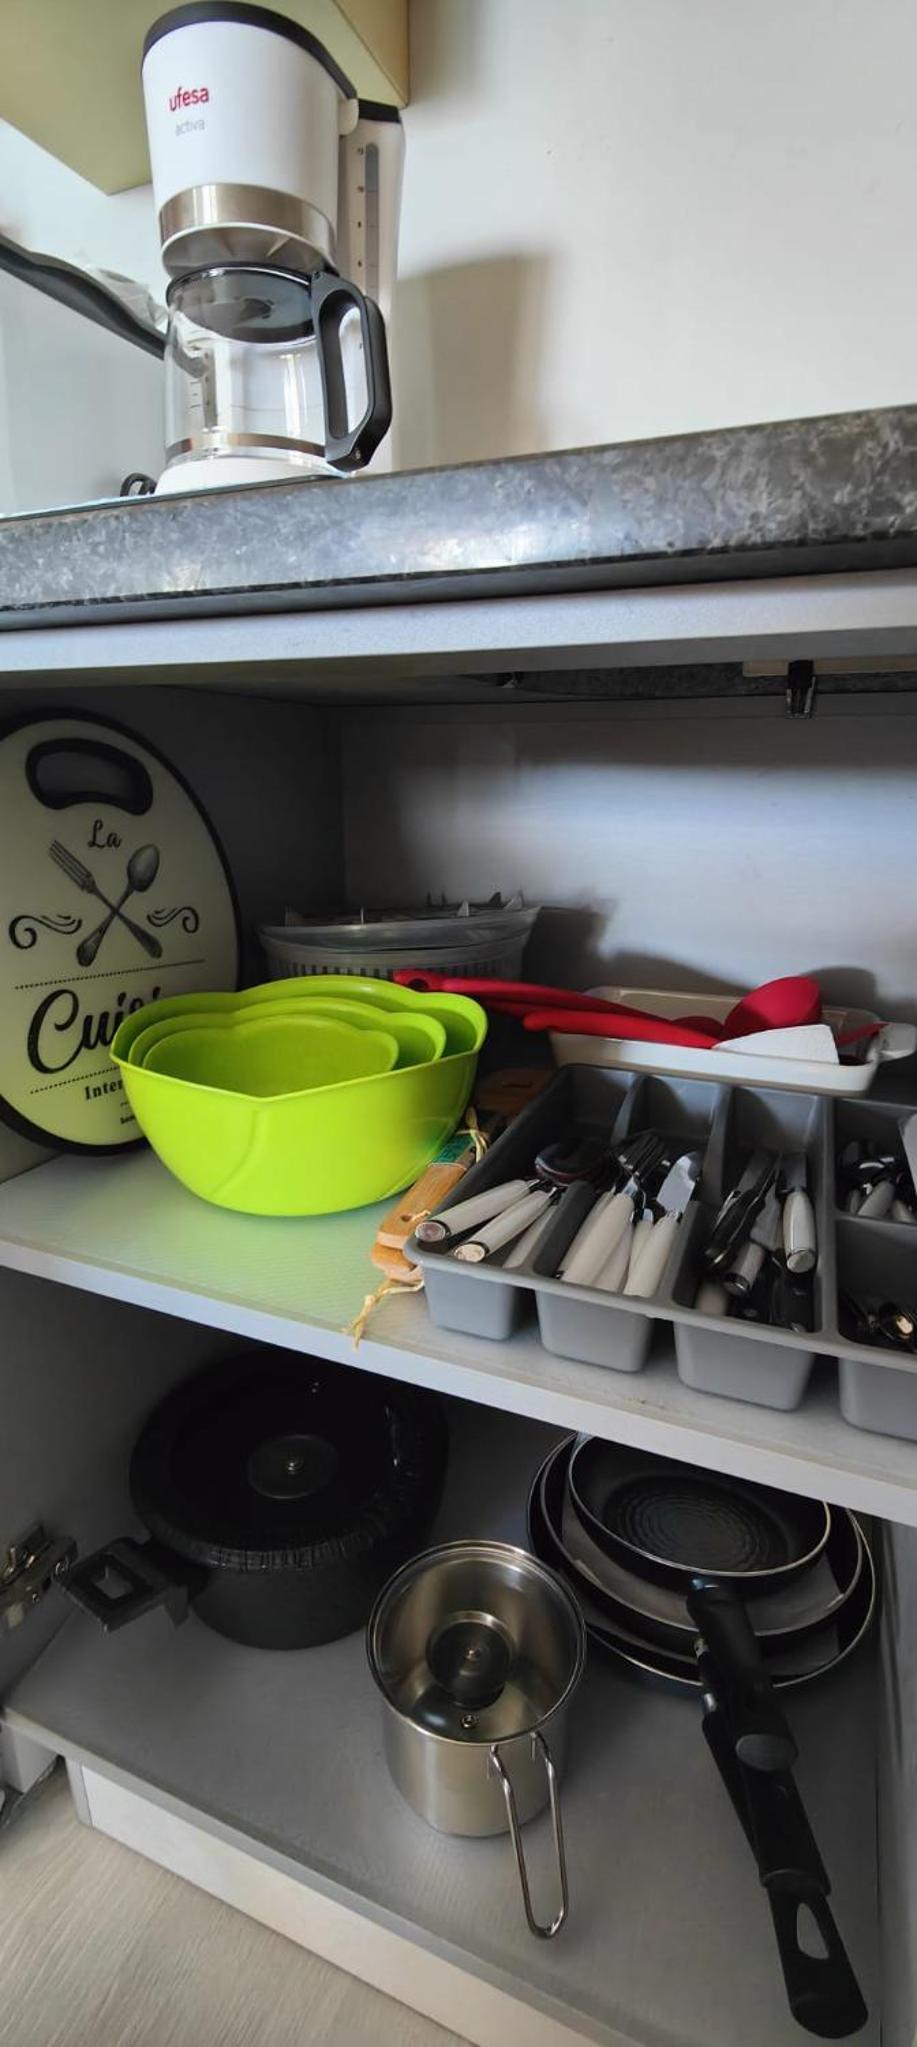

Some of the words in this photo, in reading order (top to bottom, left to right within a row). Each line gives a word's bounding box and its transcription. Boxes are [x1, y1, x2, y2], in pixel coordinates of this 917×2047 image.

[169, 86, 209, 112] ufesa
[87, 818, 122, 849] La
[27, 986, 161, 1074] Cui
